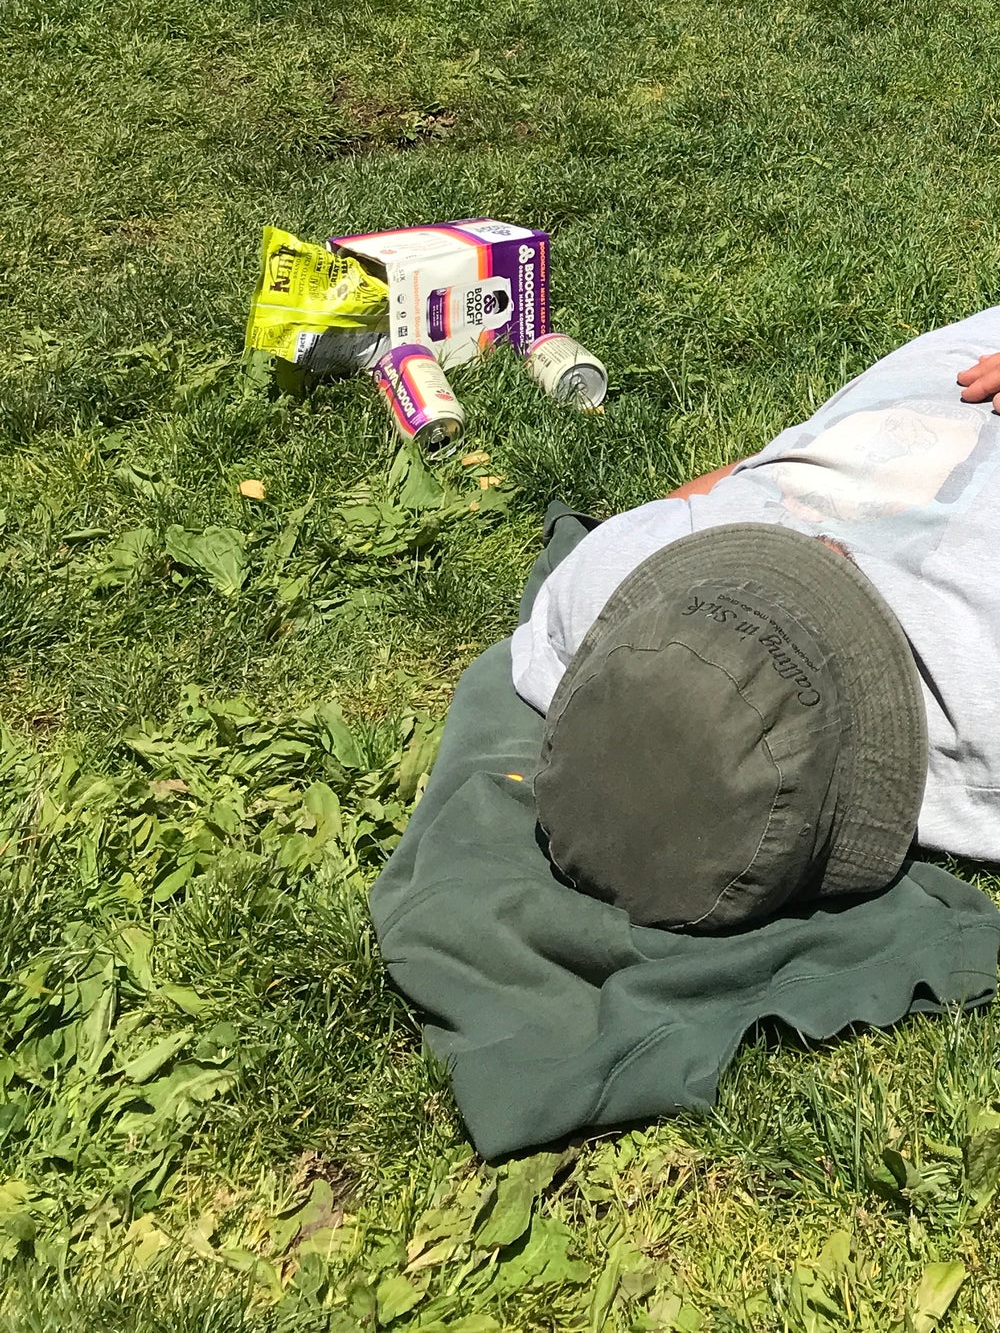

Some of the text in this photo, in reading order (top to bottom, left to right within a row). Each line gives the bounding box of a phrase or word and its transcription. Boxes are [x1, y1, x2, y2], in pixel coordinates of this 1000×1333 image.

[299, 267, 310, 297] POTATO
[466, 290, 476, 325] CRAFT
[474, 287, 483, 326] BOOCH
[298, 333, 307, 353] Facts
[769, 619, 793, 644] make
[681, 596, 821, 707] Calling in Sick
